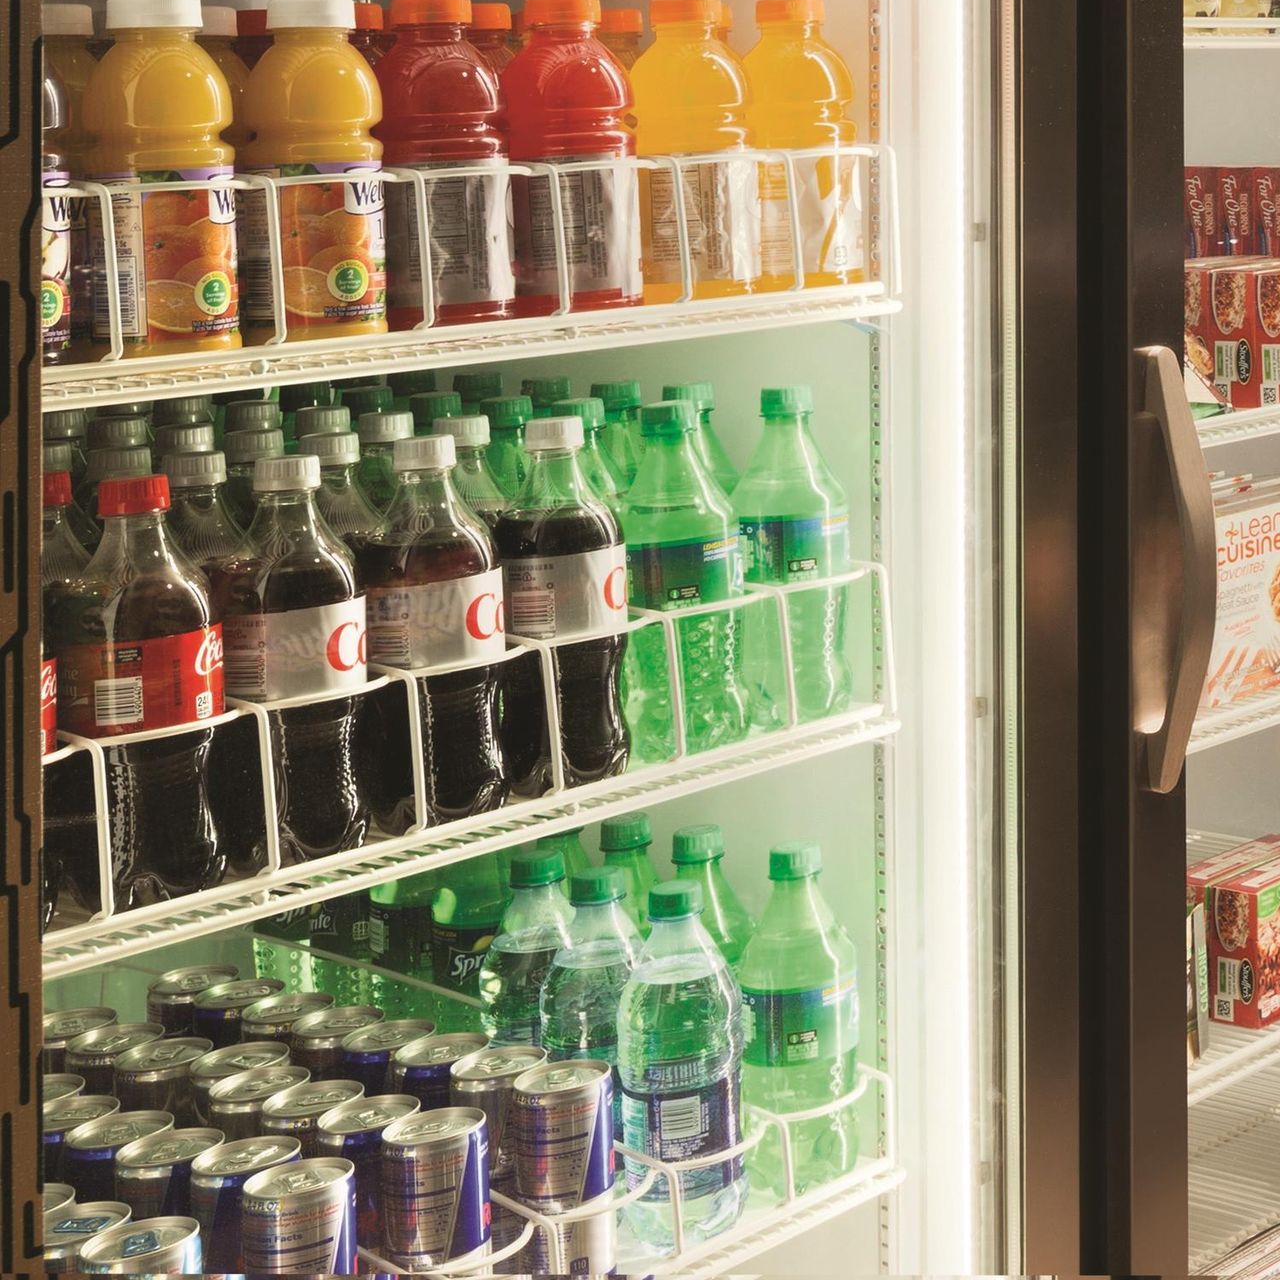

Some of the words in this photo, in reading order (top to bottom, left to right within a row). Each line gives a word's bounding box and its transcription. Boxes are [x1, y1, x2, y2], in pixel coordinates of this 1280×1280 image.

[346, 269, 354, 279] 2
[213, 282, 220, 291] 2
[573, 1259, 588, 1270] 110
